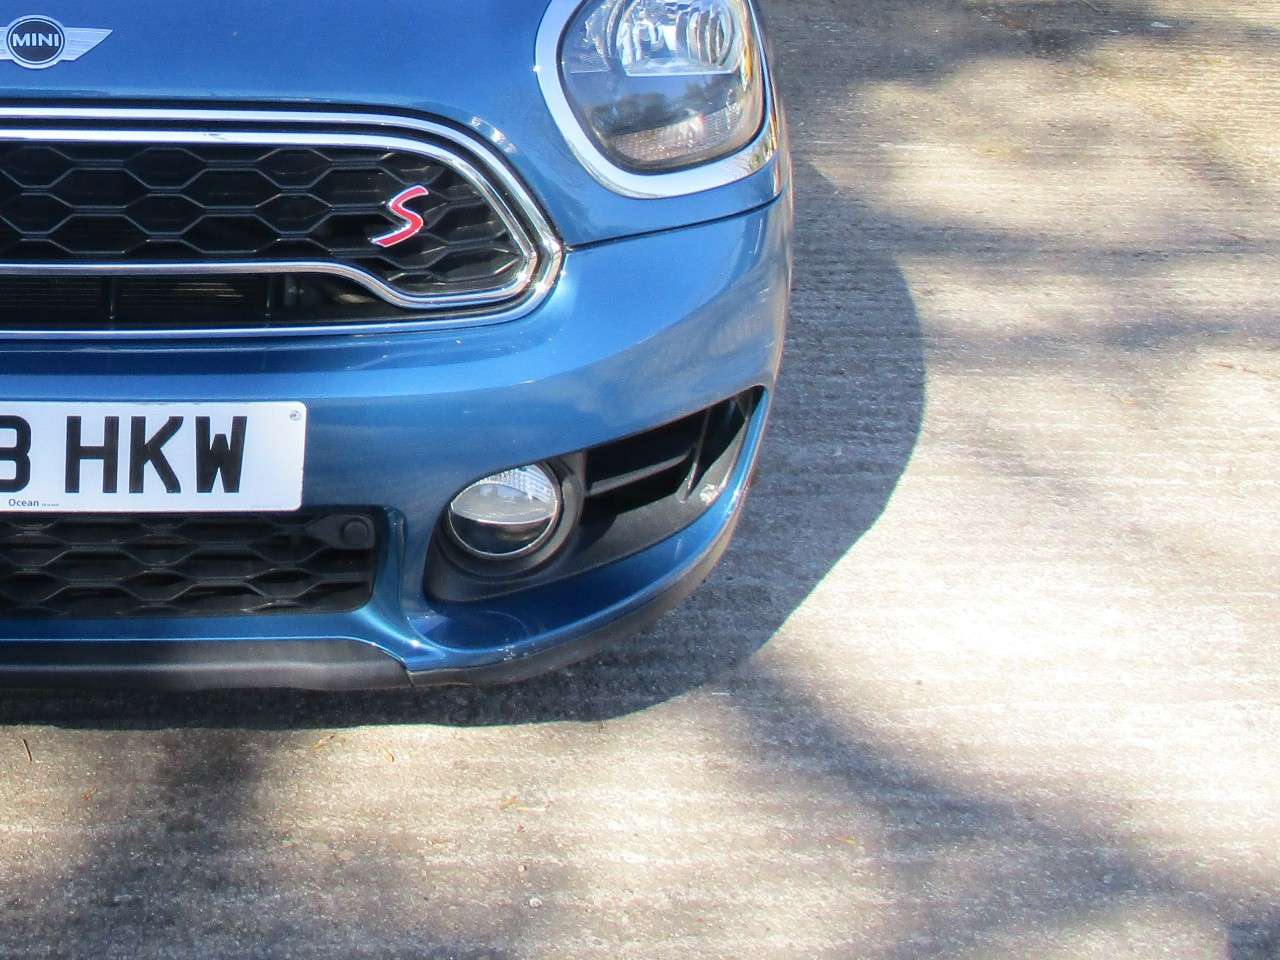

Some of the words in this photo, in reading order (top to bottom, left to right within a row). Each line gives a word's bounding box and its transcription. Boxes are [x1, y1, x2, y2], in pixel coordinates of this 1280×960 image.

[12, 32, 60, 47] MINI
[371, 185, 429, 248] S
[65, 416, 248, 494] HKW
[8, 498, 40, 507] Ocean
